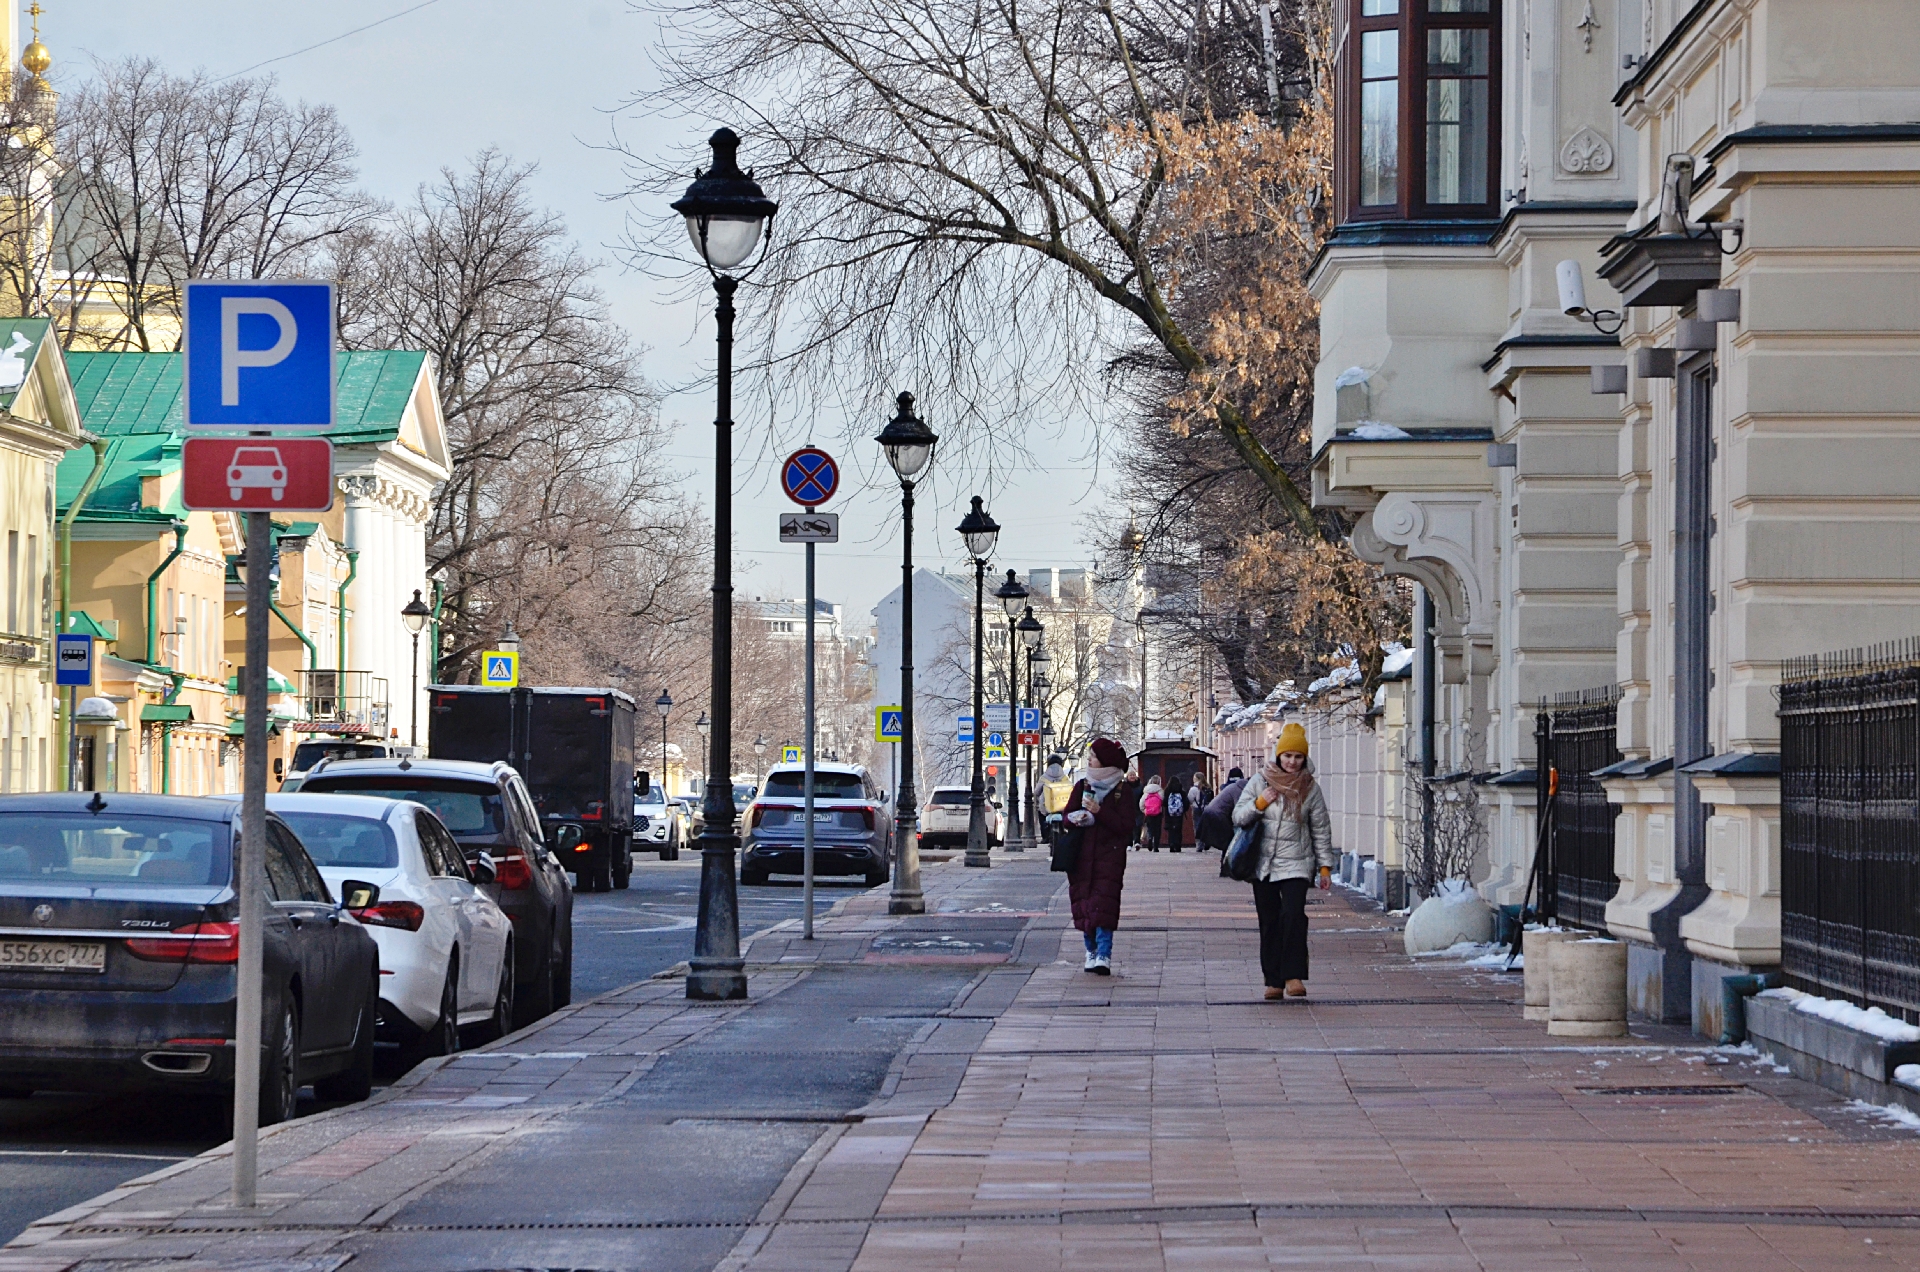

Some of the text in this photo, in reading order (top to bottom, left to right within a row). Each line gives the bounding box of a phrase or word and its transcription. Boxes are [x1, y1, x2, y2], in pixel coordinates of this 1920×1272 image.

[221, 297, 298, 406] P
[1023, 711, 1035, 728] P
[121, 920, 170, 928] 730Ld
[71, 944, 100, 960] 777
